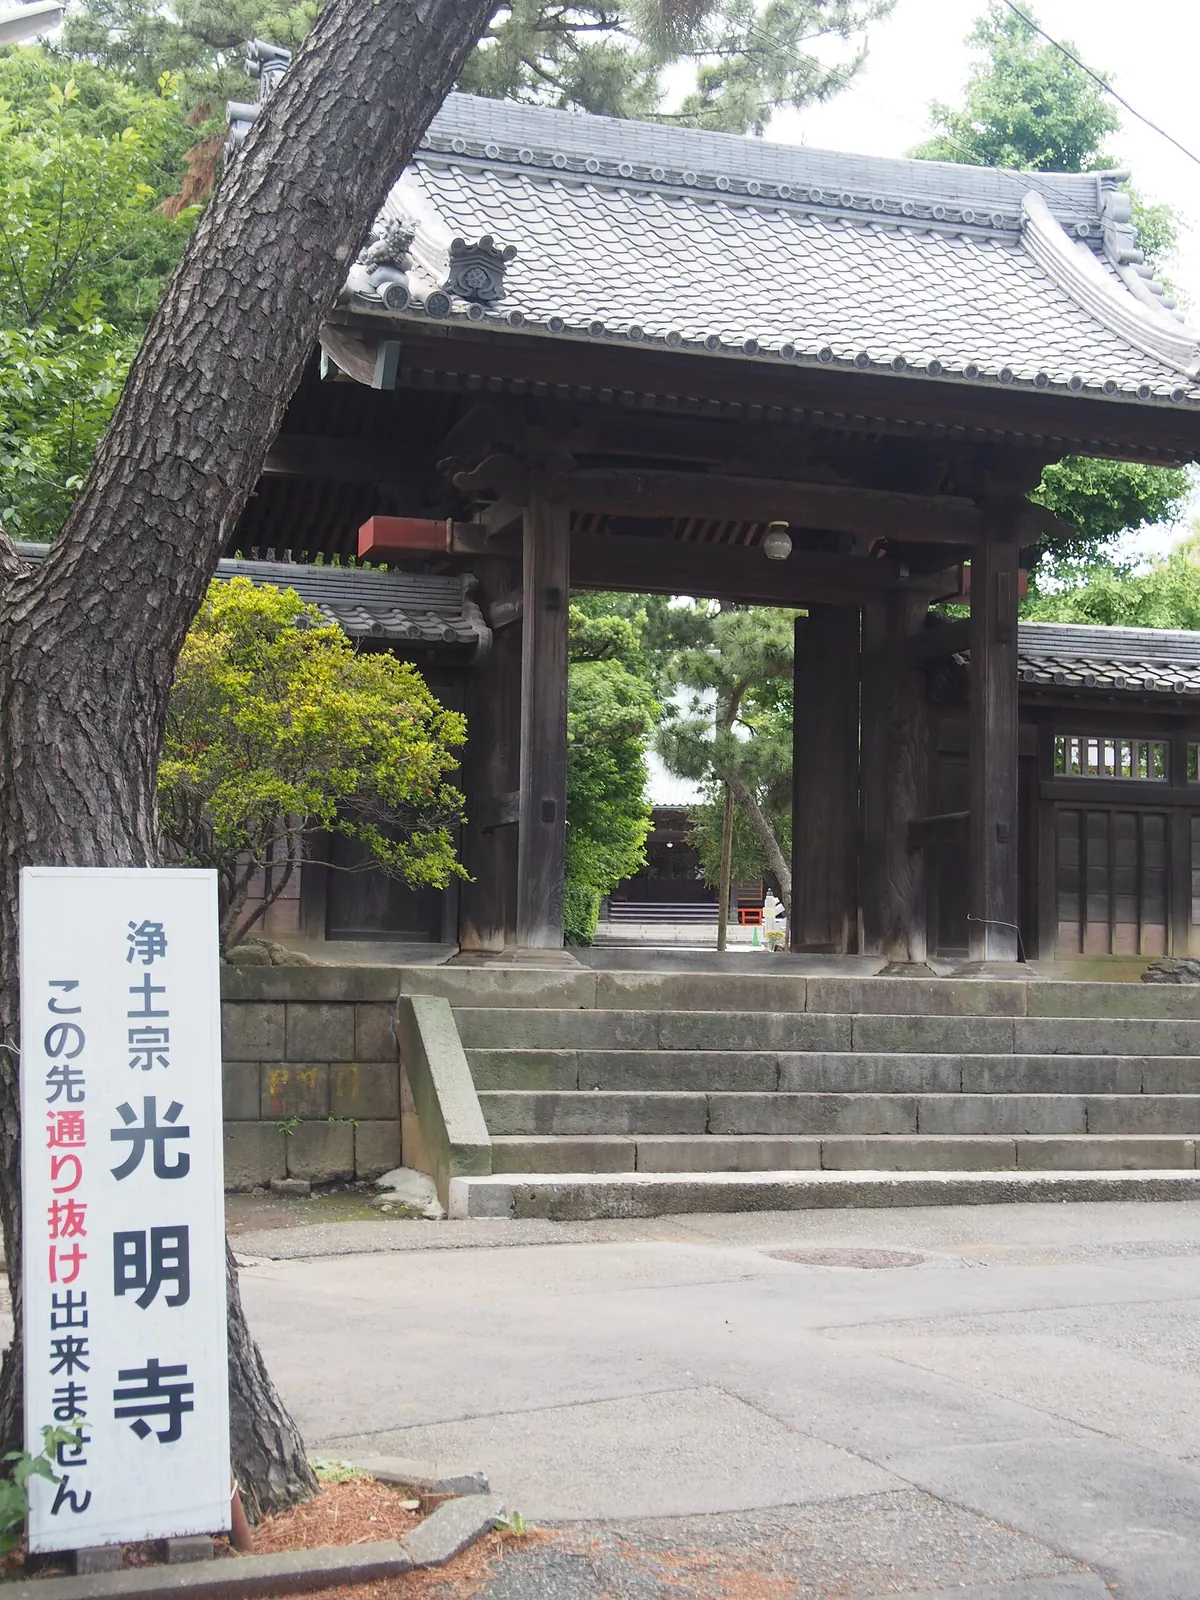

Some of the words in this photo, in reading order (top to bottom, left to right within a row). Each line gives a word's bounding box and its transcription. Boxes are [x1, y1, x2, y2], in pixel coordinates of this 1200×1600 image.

[126, 919, 170, 1071] 浄土宗
[44, 979, 91, 1516] この先通り抜け出来ません
[110, 1095, 194, 1444] 光明寺
